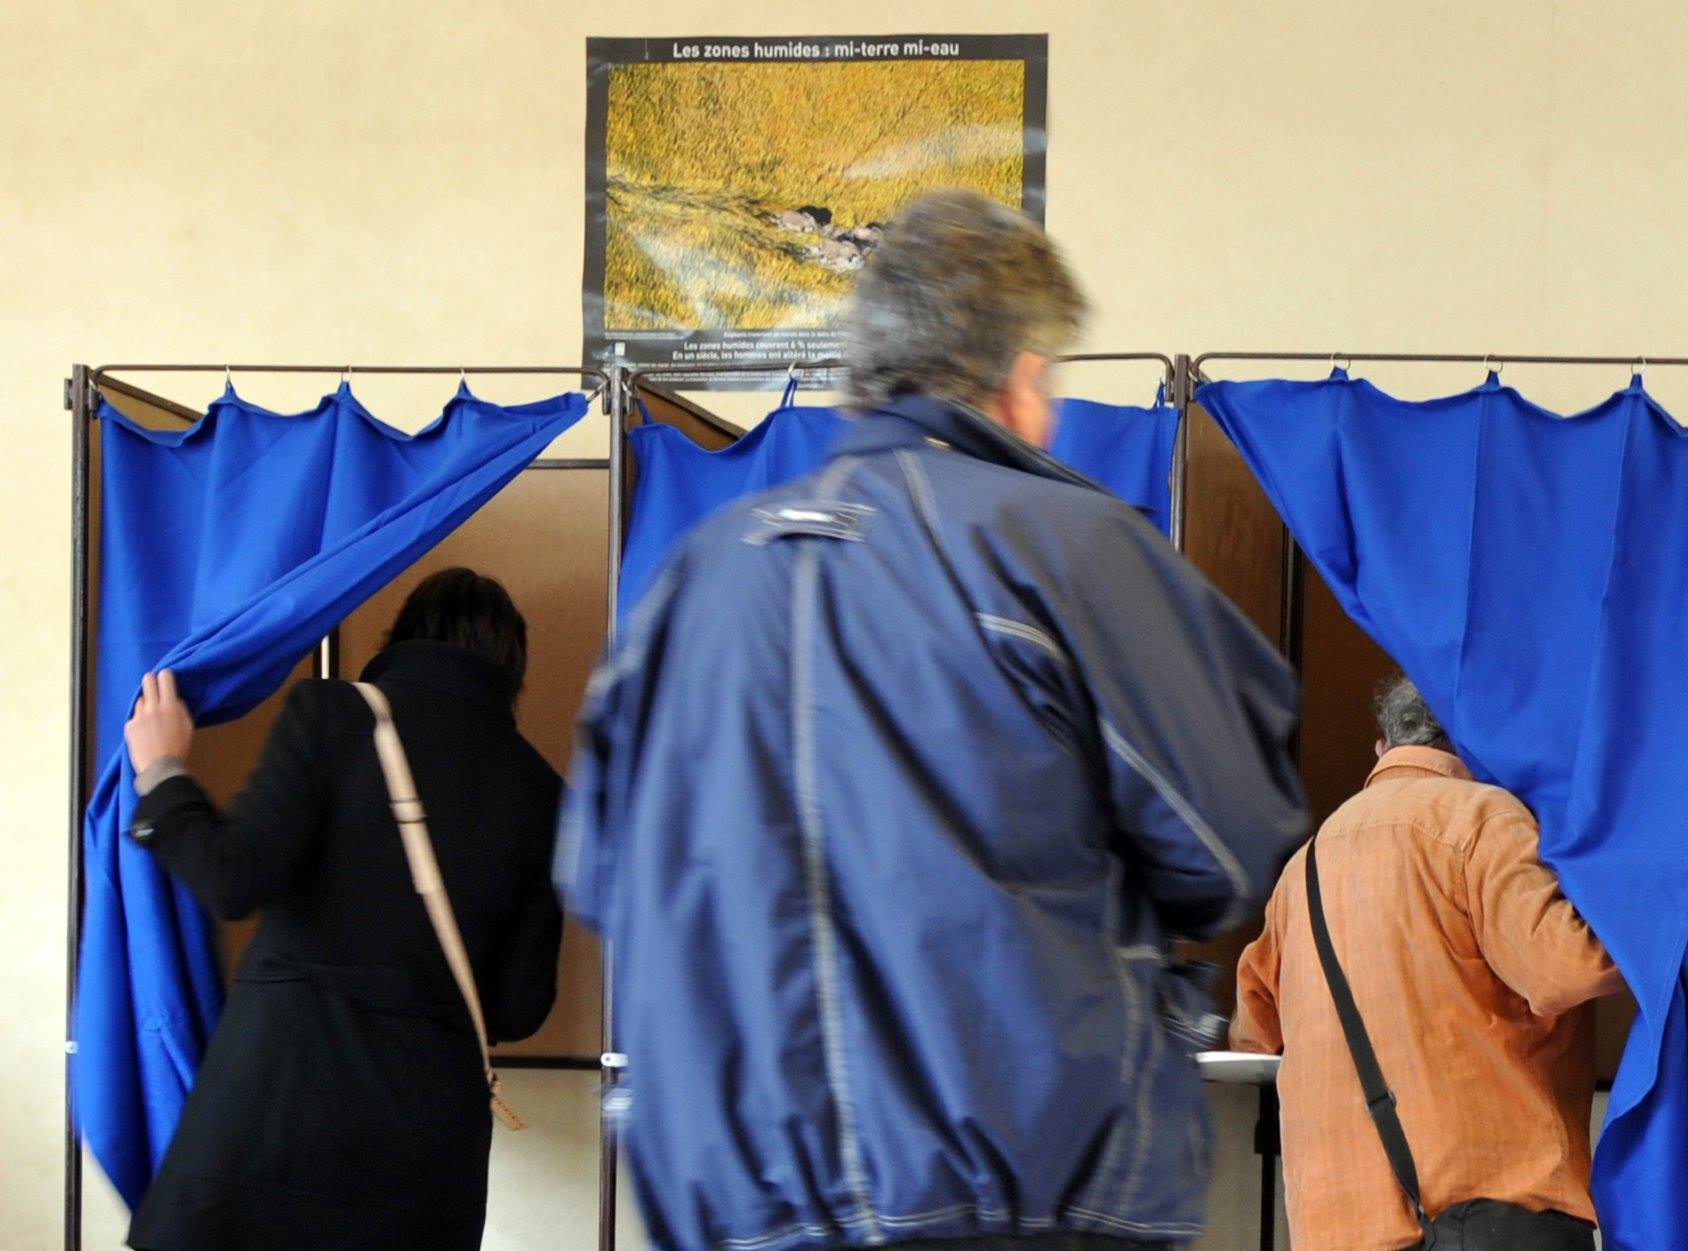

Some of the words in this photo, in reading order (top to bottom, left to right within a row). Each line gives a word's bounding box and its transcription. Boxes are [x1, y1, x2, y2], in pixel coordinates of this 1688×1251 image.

[672, 42, 700, 58] Les
[704, 45, 750, 57] zones
[754, 42, 821, 57] humides
[834, 40, 899, 57] mi-terre
[903, 39, 959, 56] mi-eau
[684, 341, 698, 350] Les
[699, 342, 721, 350] zones
[722, 341, 754, 350] humides
[755, 341, 789, 349] couvrent
[672, 351, 684, 360] En
[684, 352, 695, 360] un
[721, 351, 732, 360] les
[733, 351, 767, 359] hommes
[768, 351, 781, 359] ont
